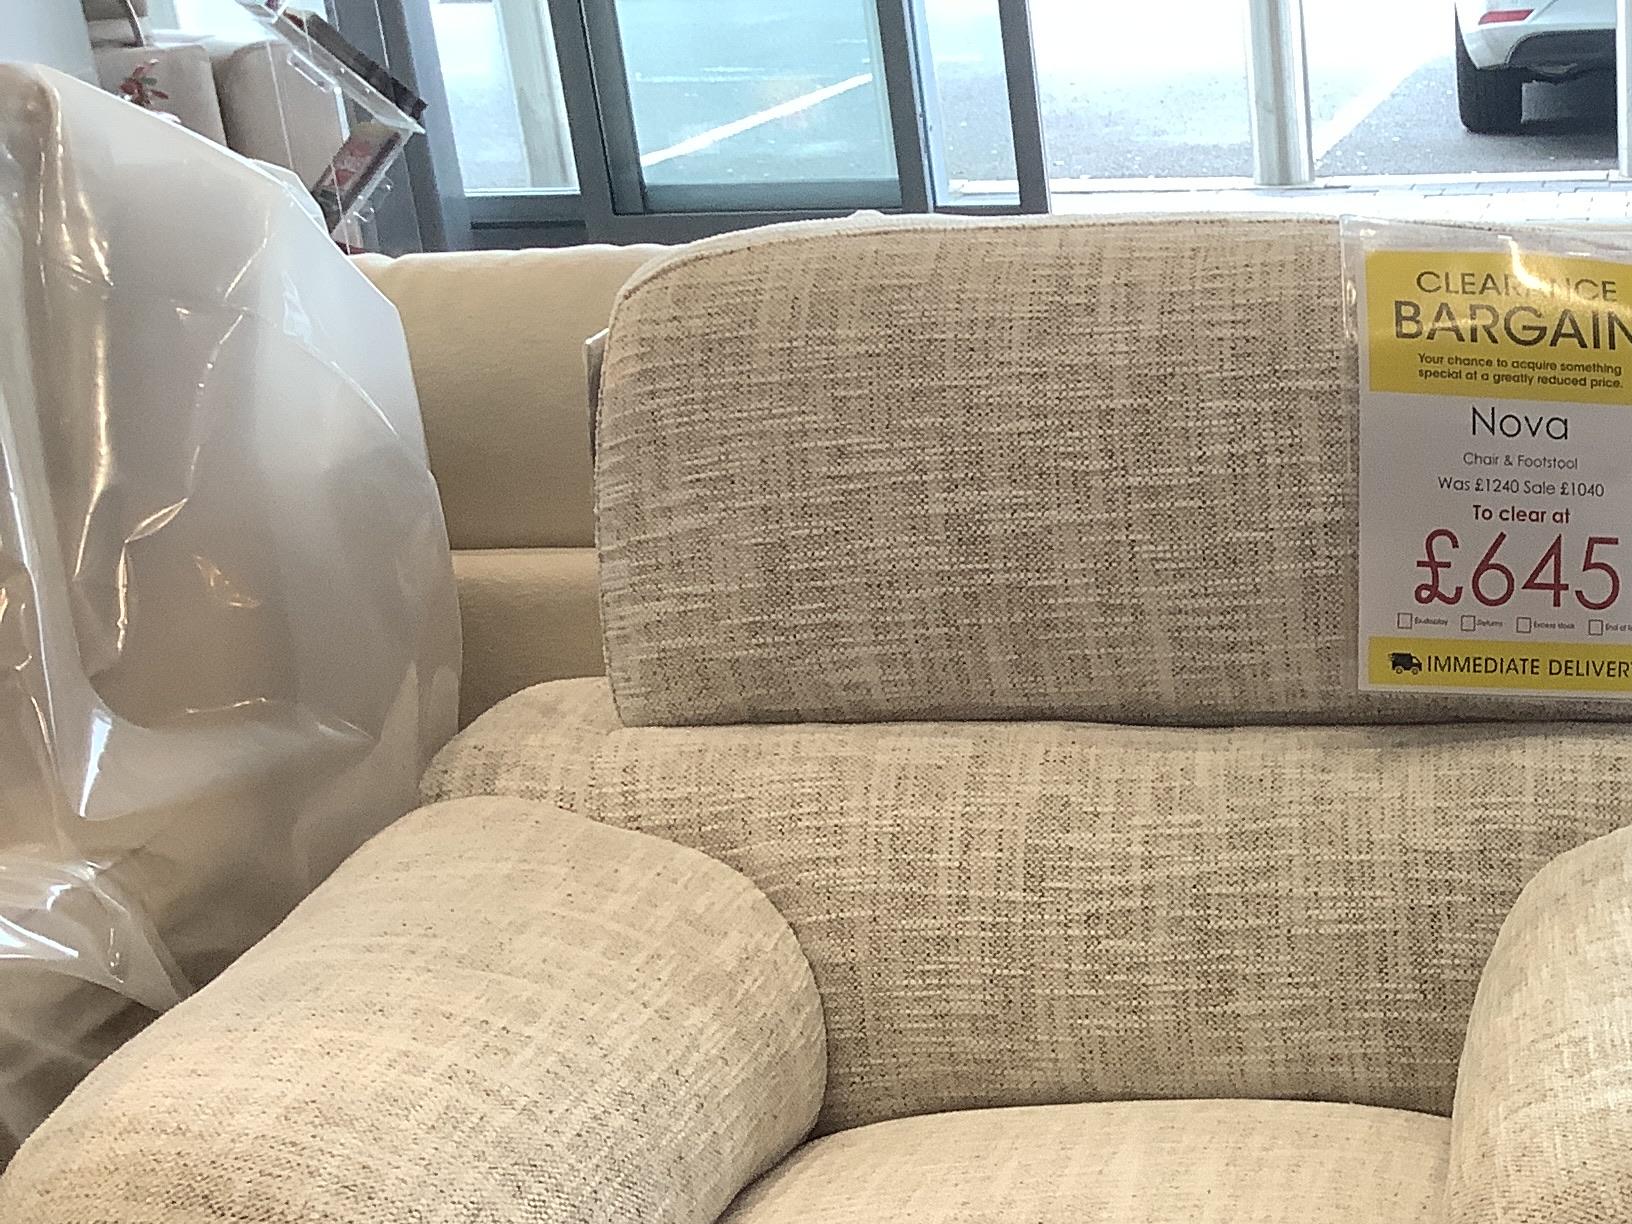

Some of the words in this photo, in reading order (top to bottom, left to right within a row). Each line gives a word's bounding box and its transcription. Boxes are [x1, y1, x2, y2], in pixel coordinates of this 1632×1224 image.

[1418, 353, 1444, 365] Your
[1447, 355, 1493, 368] chance
[1496, 358, 1508, 369] to
[1511, 359, 1557, 373] acquire
[1560, 362, 1622, 376] something
[1418, 368, 1462, 380] special
[1465, 371, 1477, 381] at
[1481, 373, 1489, 382] a
[1493, 372, 1534, 386] greatly
[1537, 374, 1587, 387] reduced
[1590, 377, 1624, 390] price.
[1472, 406, 1569, 441] Nova
[1463, 452, 1499, 466] Chair
[1504, 455, 1513, 467] &
[1517, 454, 1578, 470] Footstool
[1438, 476, 1471, 491] Was
[1474, 477, 1520, 494] £1240
[1523, 480, 1556, 495] Sale
[1560, 481, 1605, 497] £1040
[1473, 504, 1493, 521] To
[1499, 505, 1547, 523] clear
[1552, 507, 1571, 524] at
[1414, 528, 1620, 610] £645
[1427, 655, 1541, 676] IMMEDIATE
